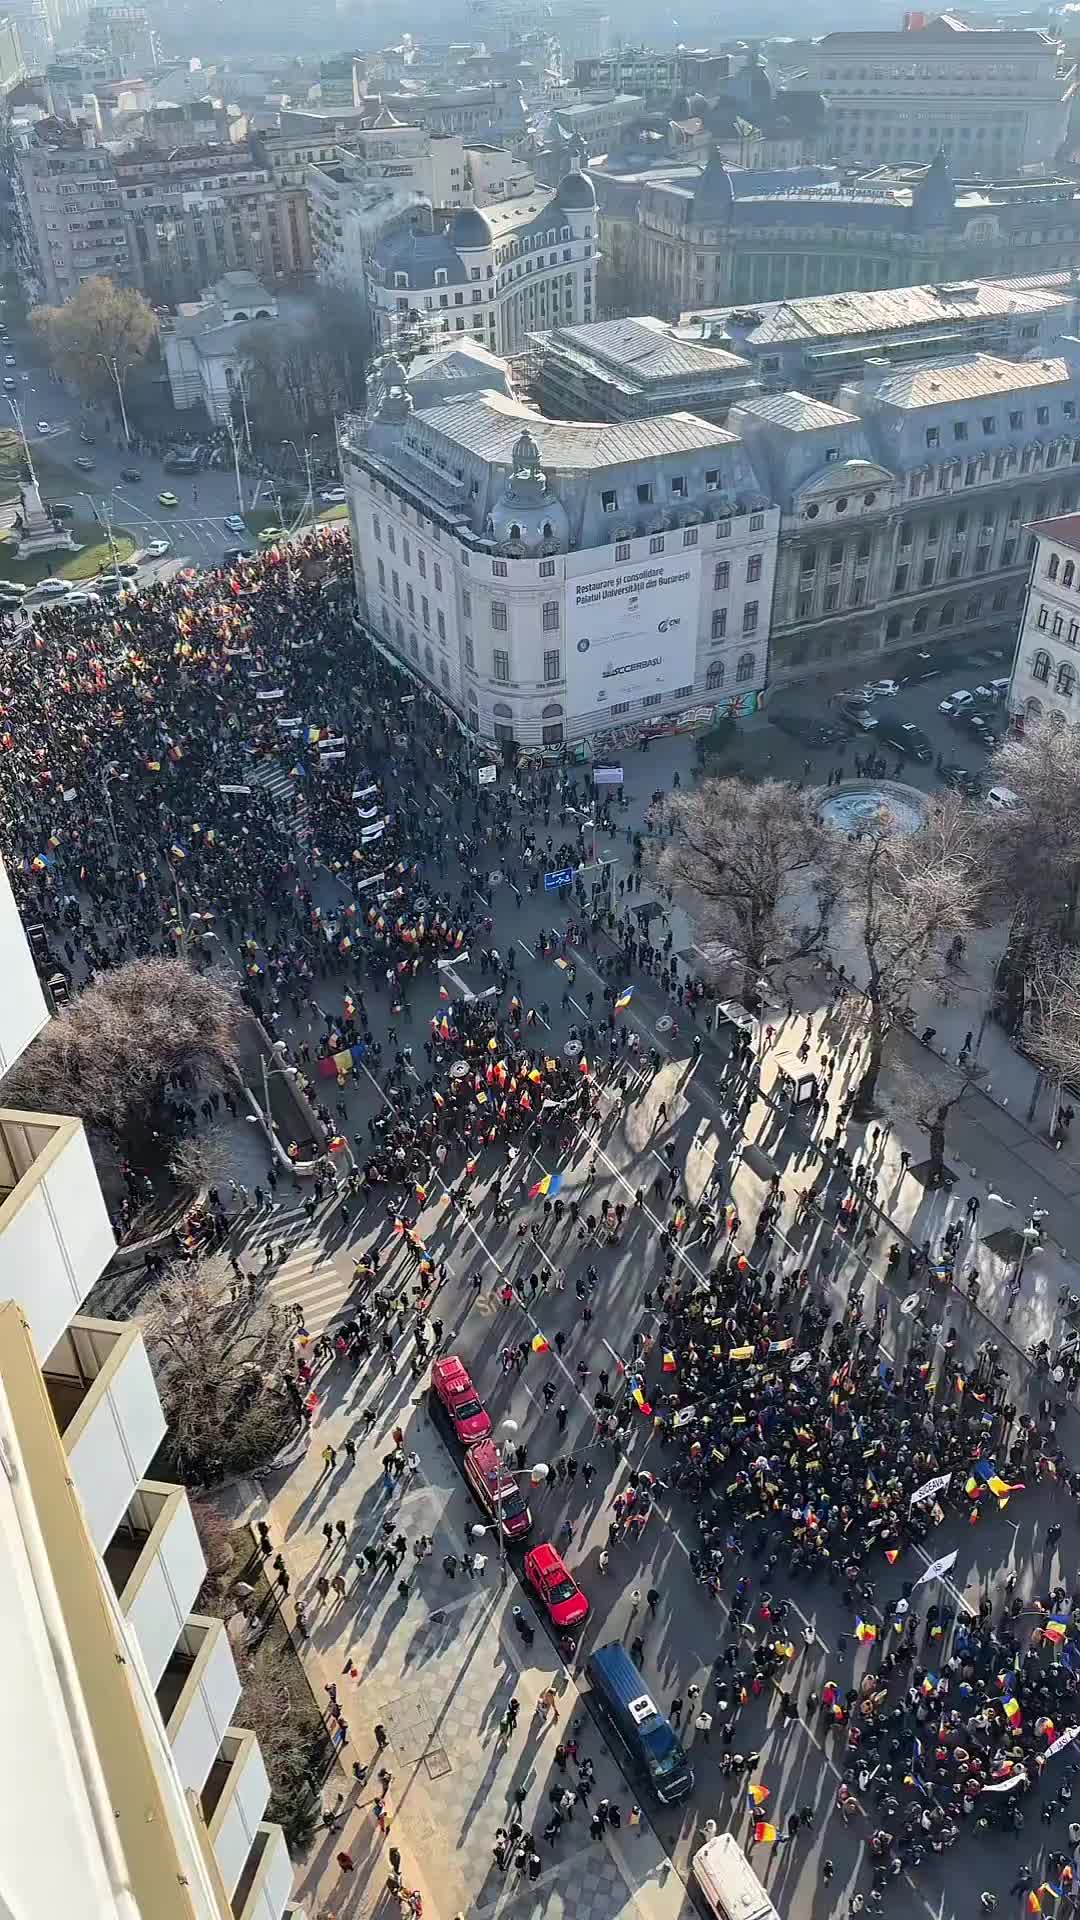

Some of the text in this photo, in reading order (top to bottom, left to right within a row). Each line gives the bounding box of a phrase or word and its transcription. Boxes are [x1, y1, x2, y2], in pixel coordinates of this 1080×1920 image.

[576, 580, 615, 594] Restaurare
[623, 568, 664, 583] consolidare
[576, 593, 601, 605] Palatul
[646, 579, 657, 589] din
